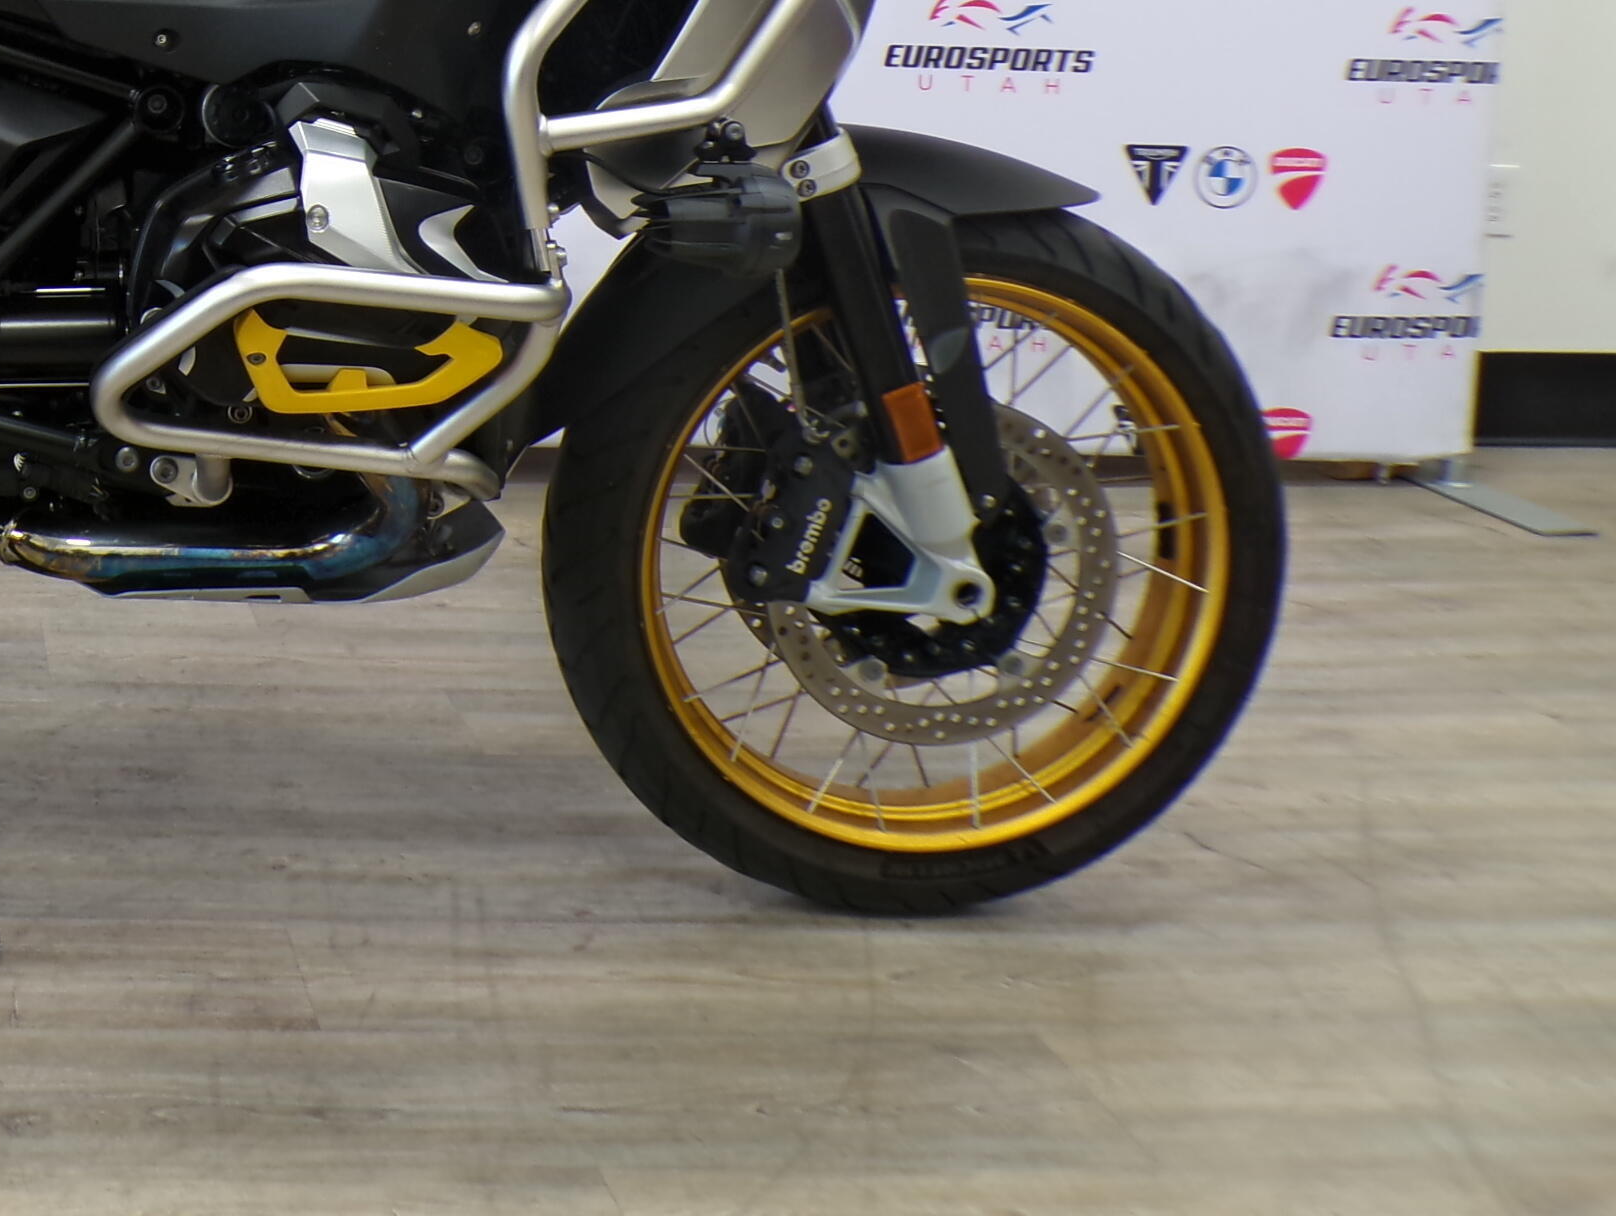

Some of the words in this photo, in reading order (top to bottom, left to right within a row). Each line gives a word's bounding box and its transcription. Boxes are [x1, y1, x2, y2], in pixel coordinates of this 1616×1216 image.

[885, 44, 1095, 74] EUROSPORTS
[918, 74, 1062, 96] UTAH
[785, 498, 832, 575] brembo
